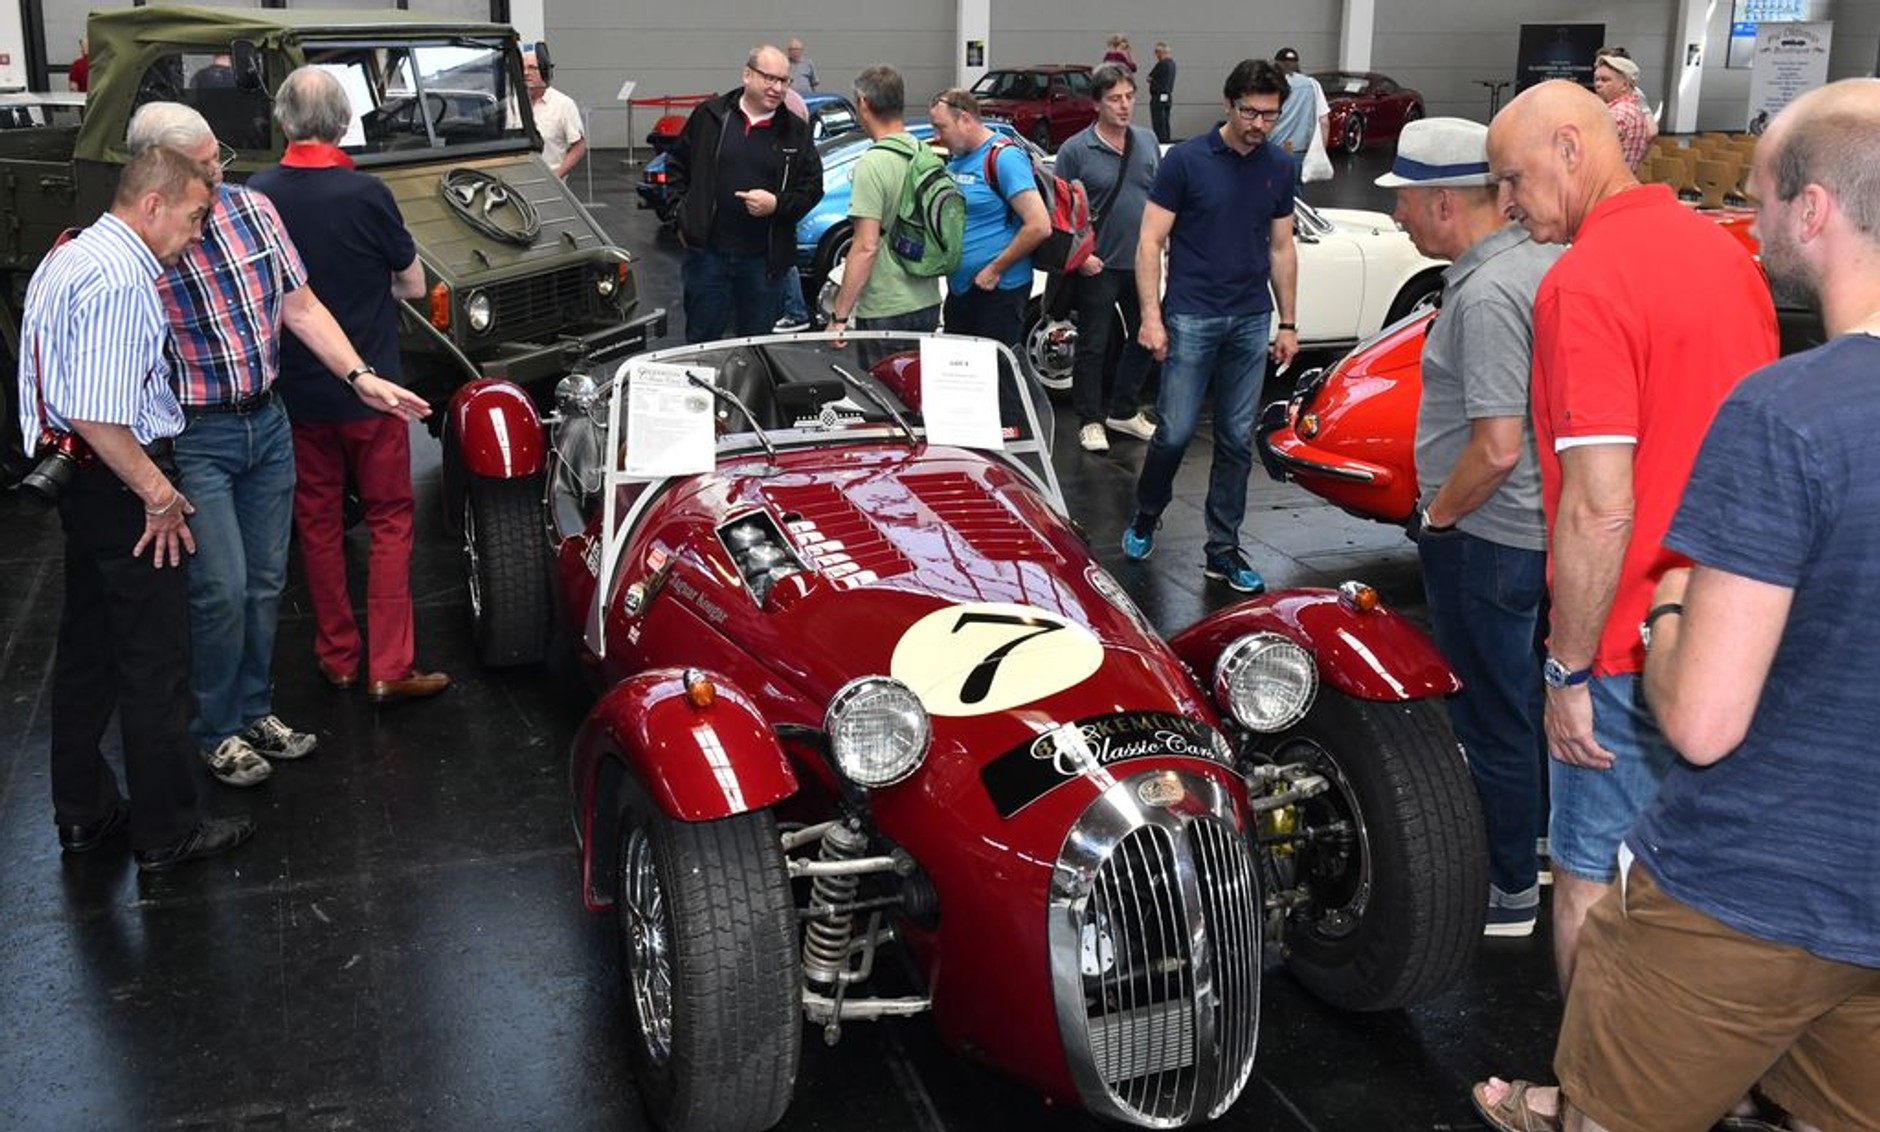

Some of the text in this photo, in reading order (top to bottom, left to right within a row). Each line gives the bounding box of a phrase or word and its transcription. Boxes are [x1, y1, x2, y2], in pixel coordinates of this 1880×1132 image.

[950, 612, 1066, 704] 7
[1030, 722, 1215, 775] Classic Cars
